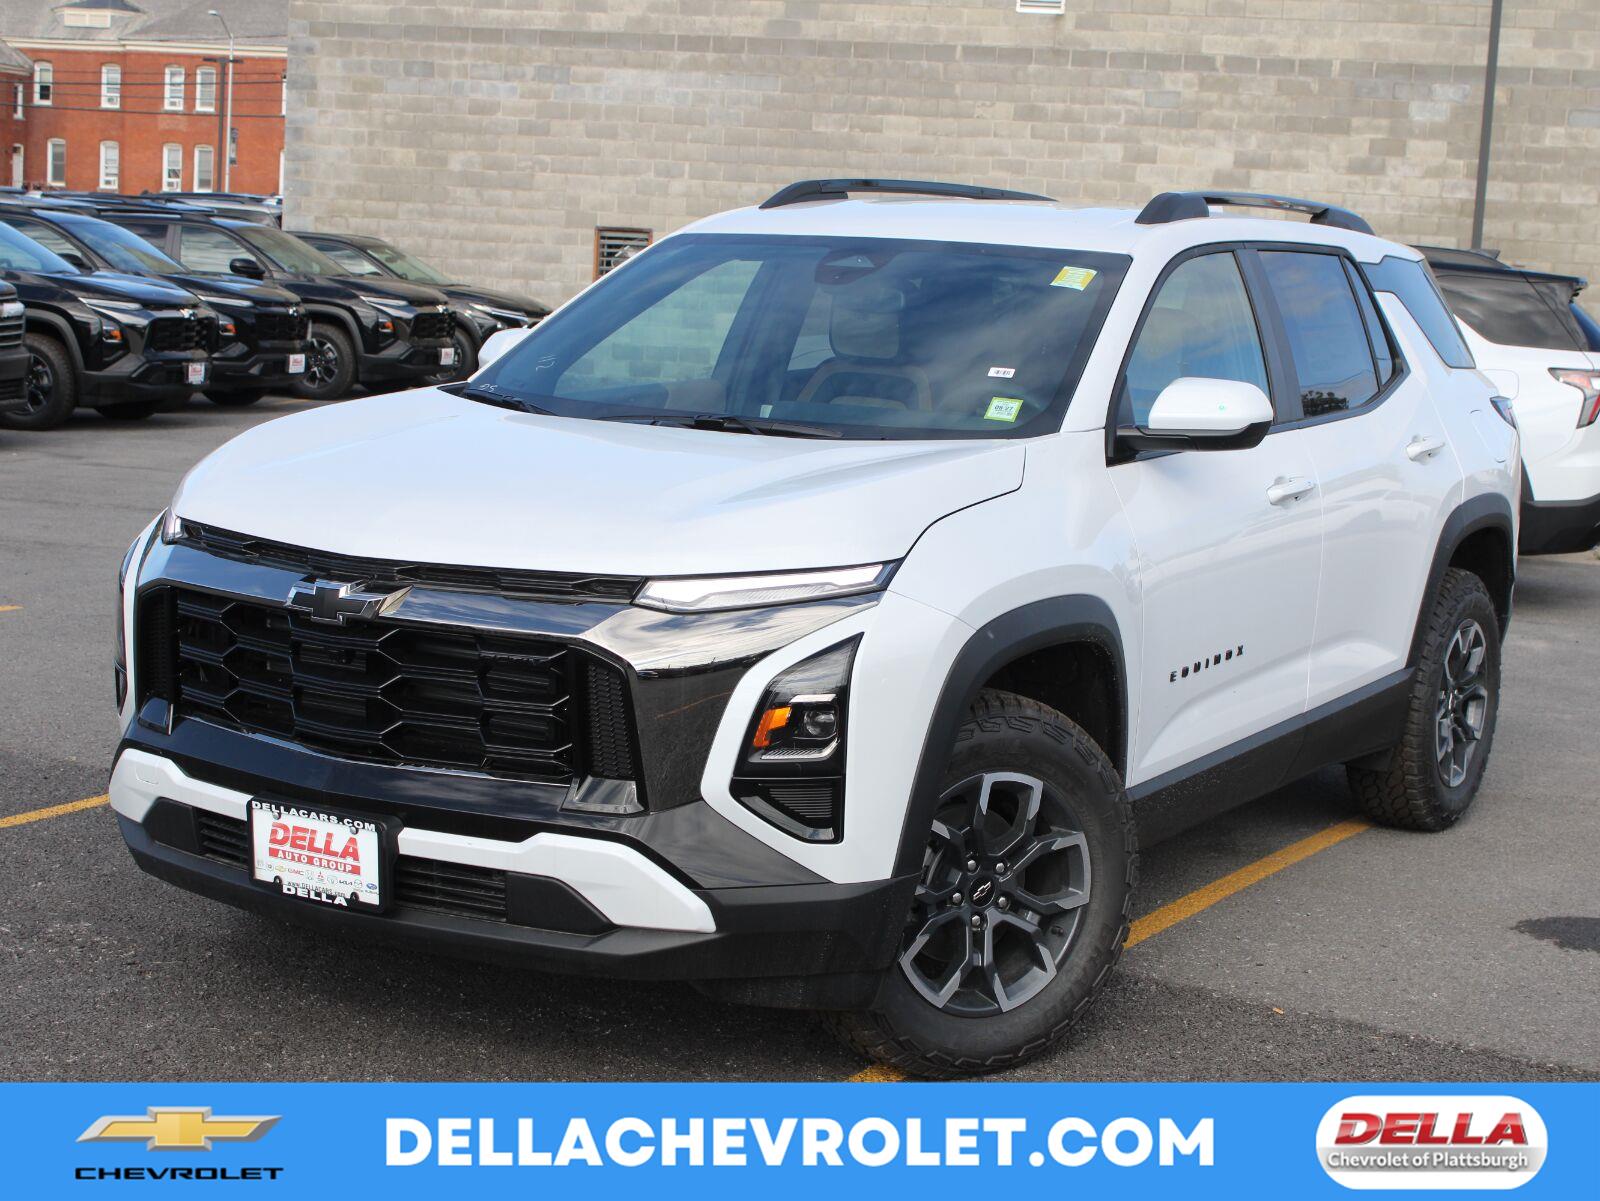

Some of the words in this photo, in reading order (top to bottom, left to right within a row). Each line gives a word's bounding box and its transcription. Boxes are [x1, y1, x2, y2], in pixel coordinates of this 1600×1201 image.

[252, 800, 376, 832] DELLACARS.COM
[269, 821, 360, 862] DELLA
[277, 850, 308, 863] AUTO
[313, 859, 353, 873] GROUP
[282, 884, 349, 906] DELLA
